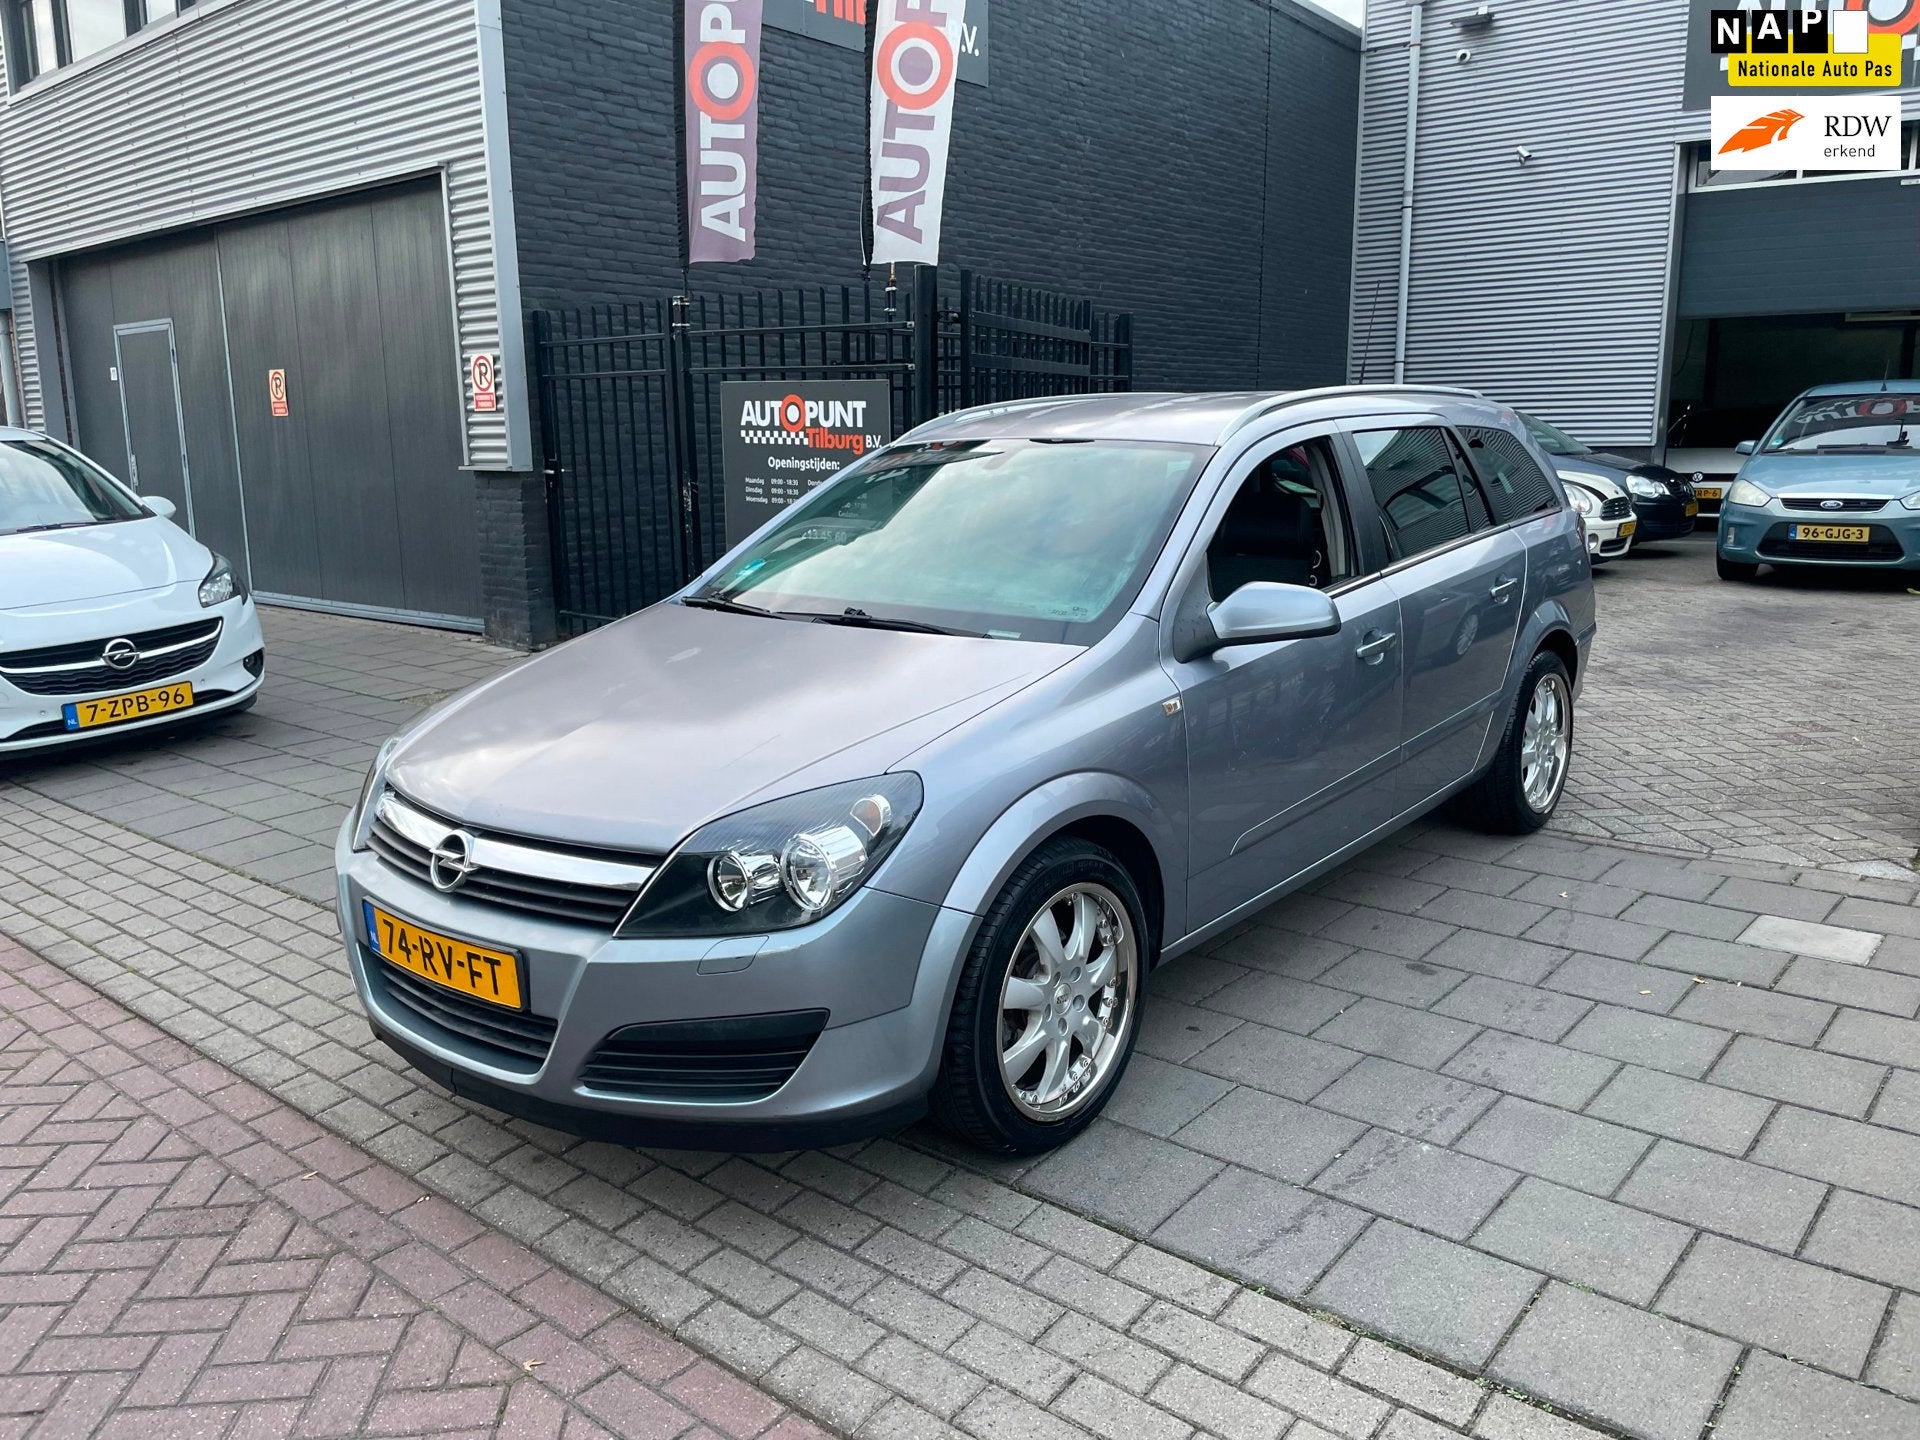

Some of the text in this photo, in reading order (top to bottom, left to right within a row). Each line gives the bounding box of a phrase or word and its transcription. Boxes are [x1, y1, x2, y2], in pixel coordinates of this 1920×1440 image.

[689, 0, 755, 242] AUTOP
[740, 394, 867, 432] AUTOPUNT
[805, 427, 882, 455] Tilburg B.V.
[767, 456, 841, 473] Openingstijden:
[745, 477, 765, 486] Maandag
[745, 486, 763, 495] Dinsdag
[1802, 527, 1864, 540] 96-GJG-3
[86, 687, 185, 723] 7-ZPB-96
[382, 917, 502, 995] 74-RV-FT
